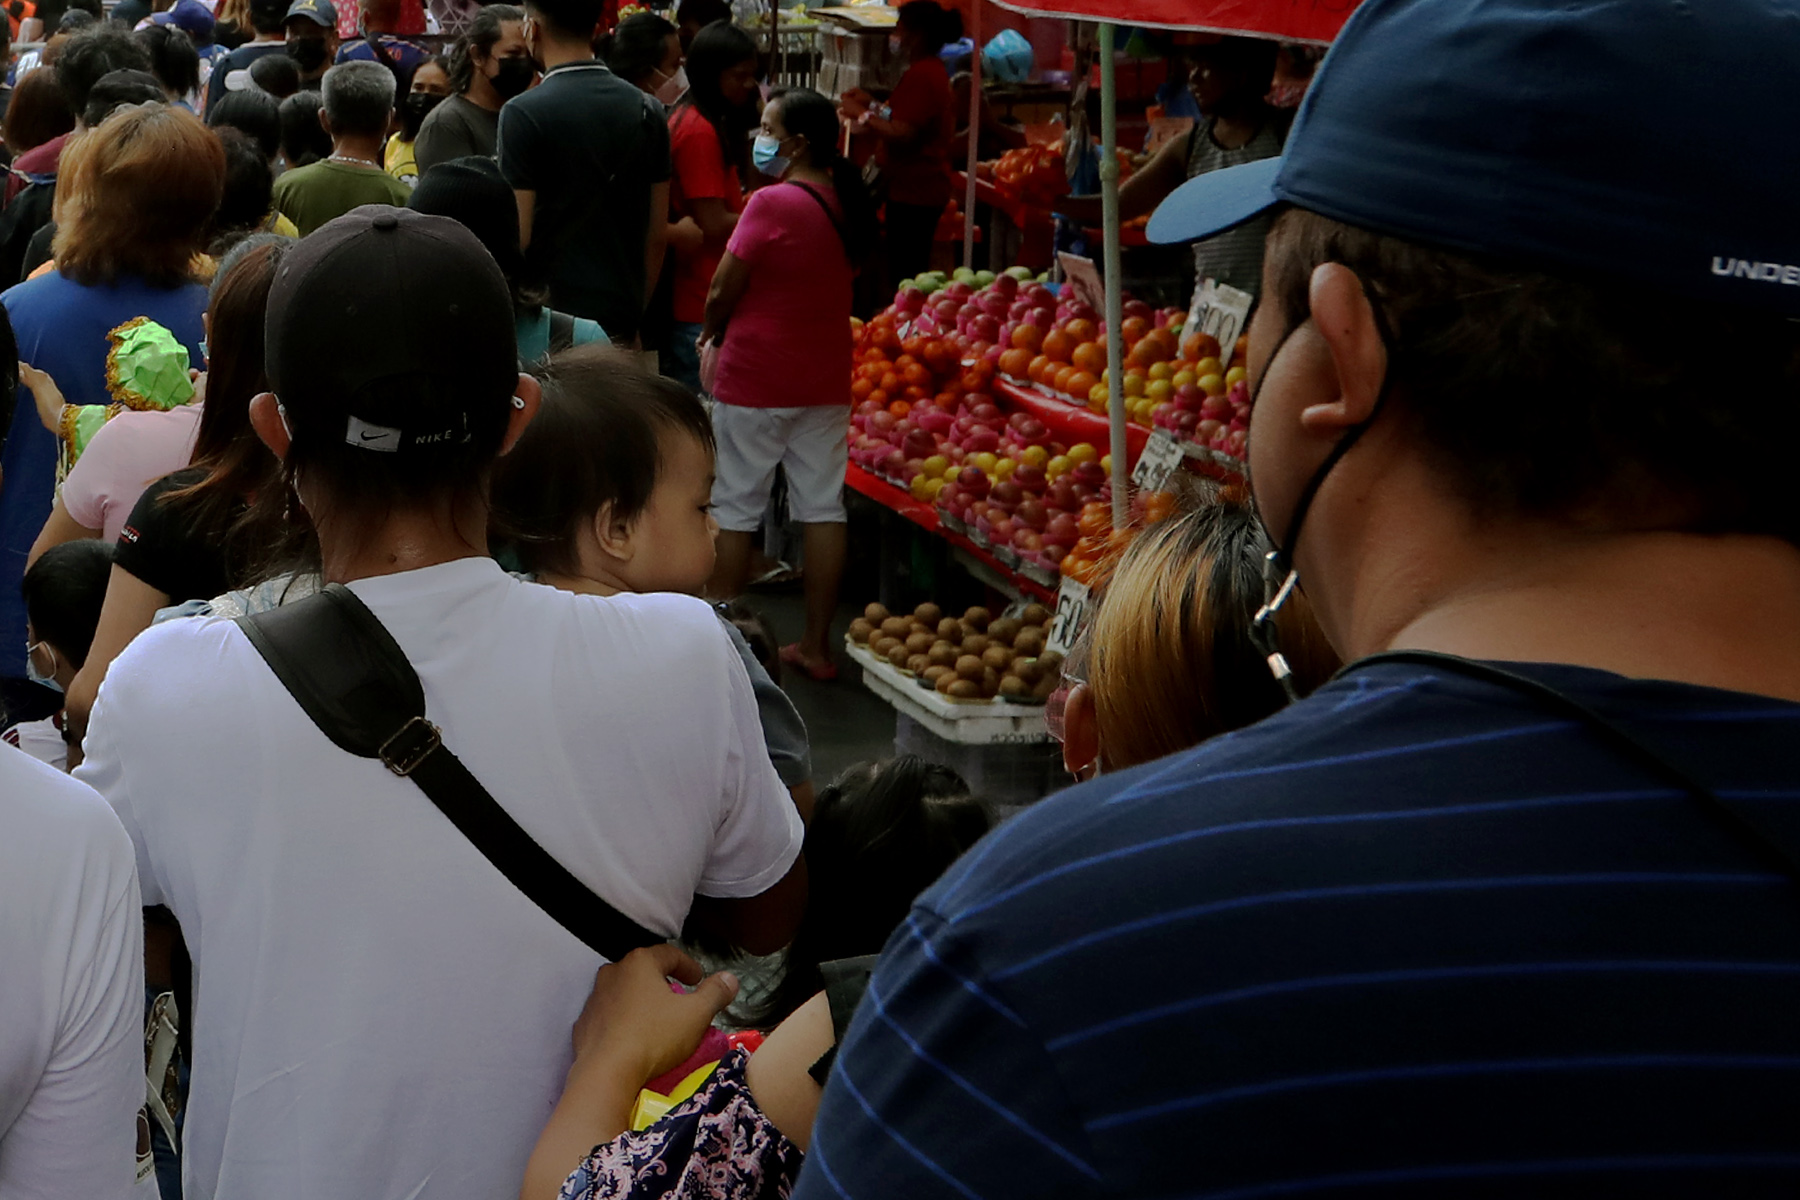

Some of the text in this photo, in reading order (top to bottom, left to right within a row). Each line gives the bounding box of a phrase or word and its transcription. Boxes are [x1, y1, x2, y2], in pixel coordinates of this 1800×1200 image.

[1711, 256, 1800, 287] UNDE
[415, 429, 453, 445] NIKE
[1052, 594, 1083, 649] 50
